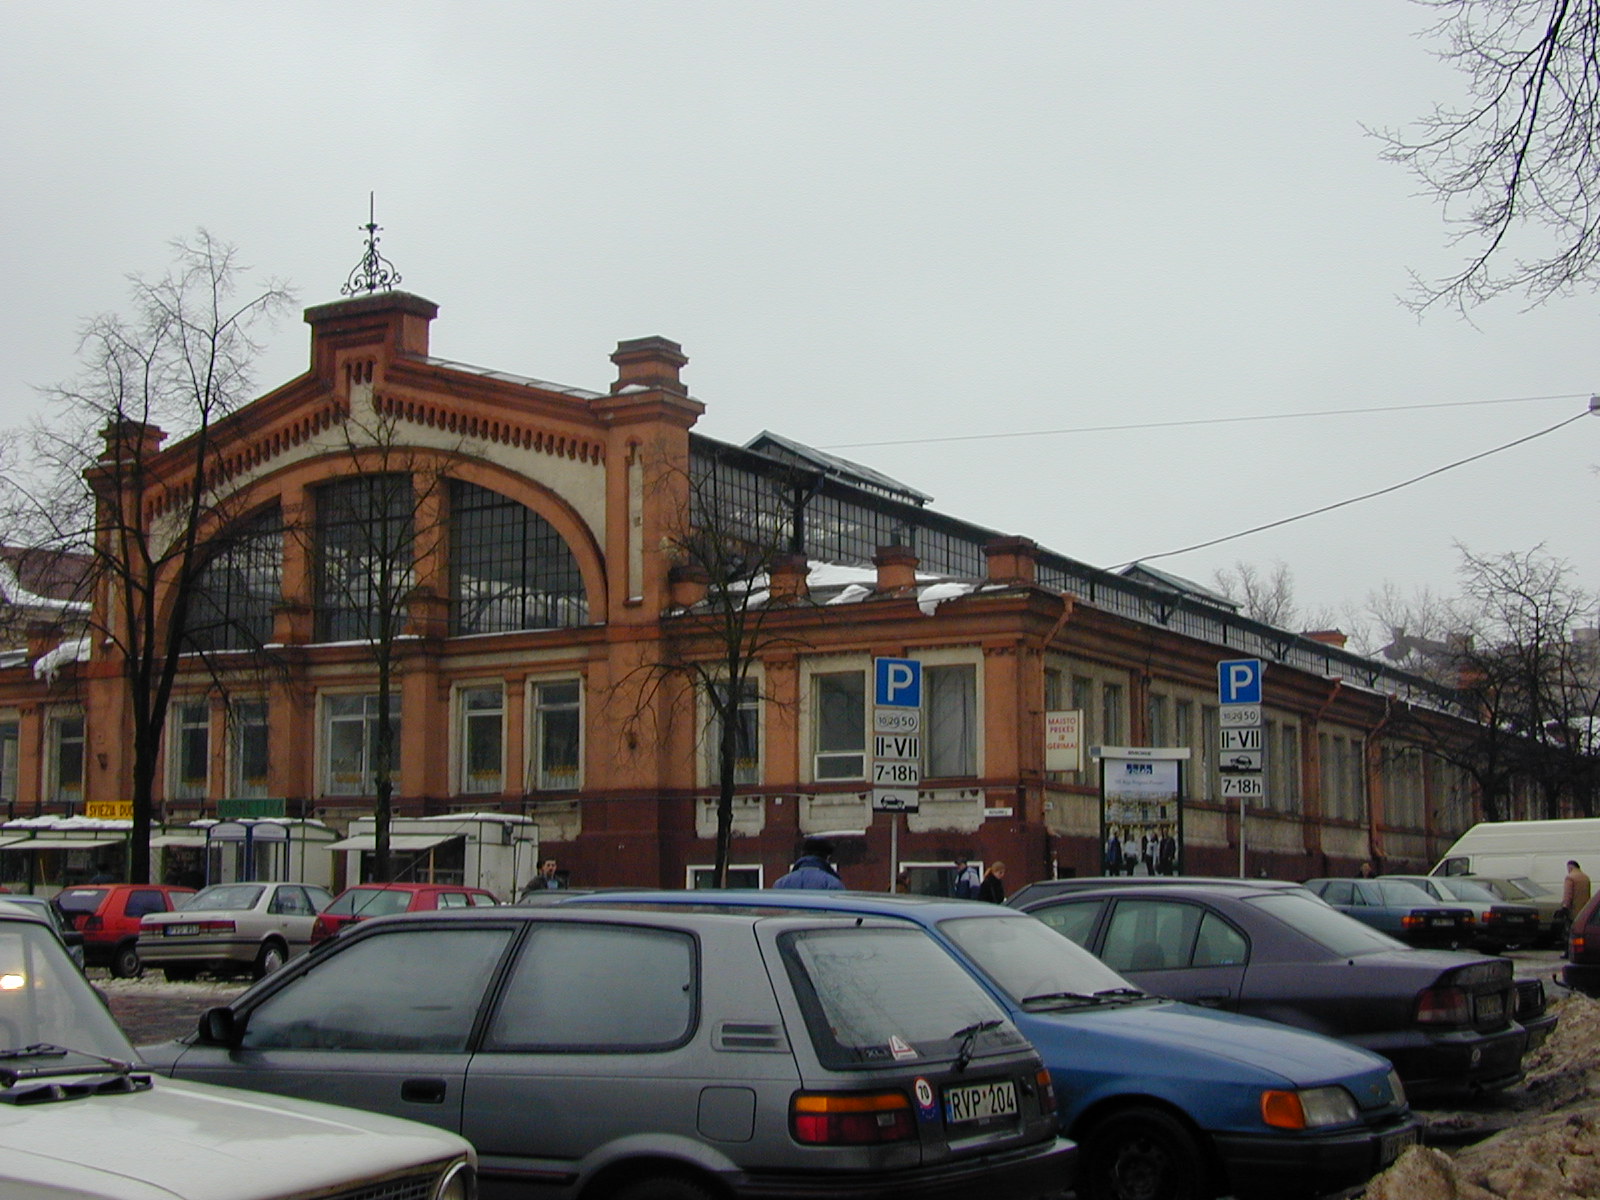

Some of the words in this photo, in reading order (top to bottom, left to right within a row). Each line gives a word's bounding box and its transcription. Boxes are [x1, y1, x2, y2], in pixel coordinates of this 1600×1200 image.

[887, 663, 914, 702] P
[1229, 664, 1253, 700] P
[901, 716, 915, 727] 50
[1047, 717, 1077, 725] MAISTO
[1243, 711, 1256, 720] 50
[875, 736, 918, 758] II-VII
[1221, 730, 1260, 749] II-VII
[875, 764, 918, 782] 7-18h
[1222, 779, 1261, 794] 7-18h
[918, 1085, 930, 1100] 70
[951, 1088, 981, 1120] RVP
[988, 1083, 1015, 1114] 204
